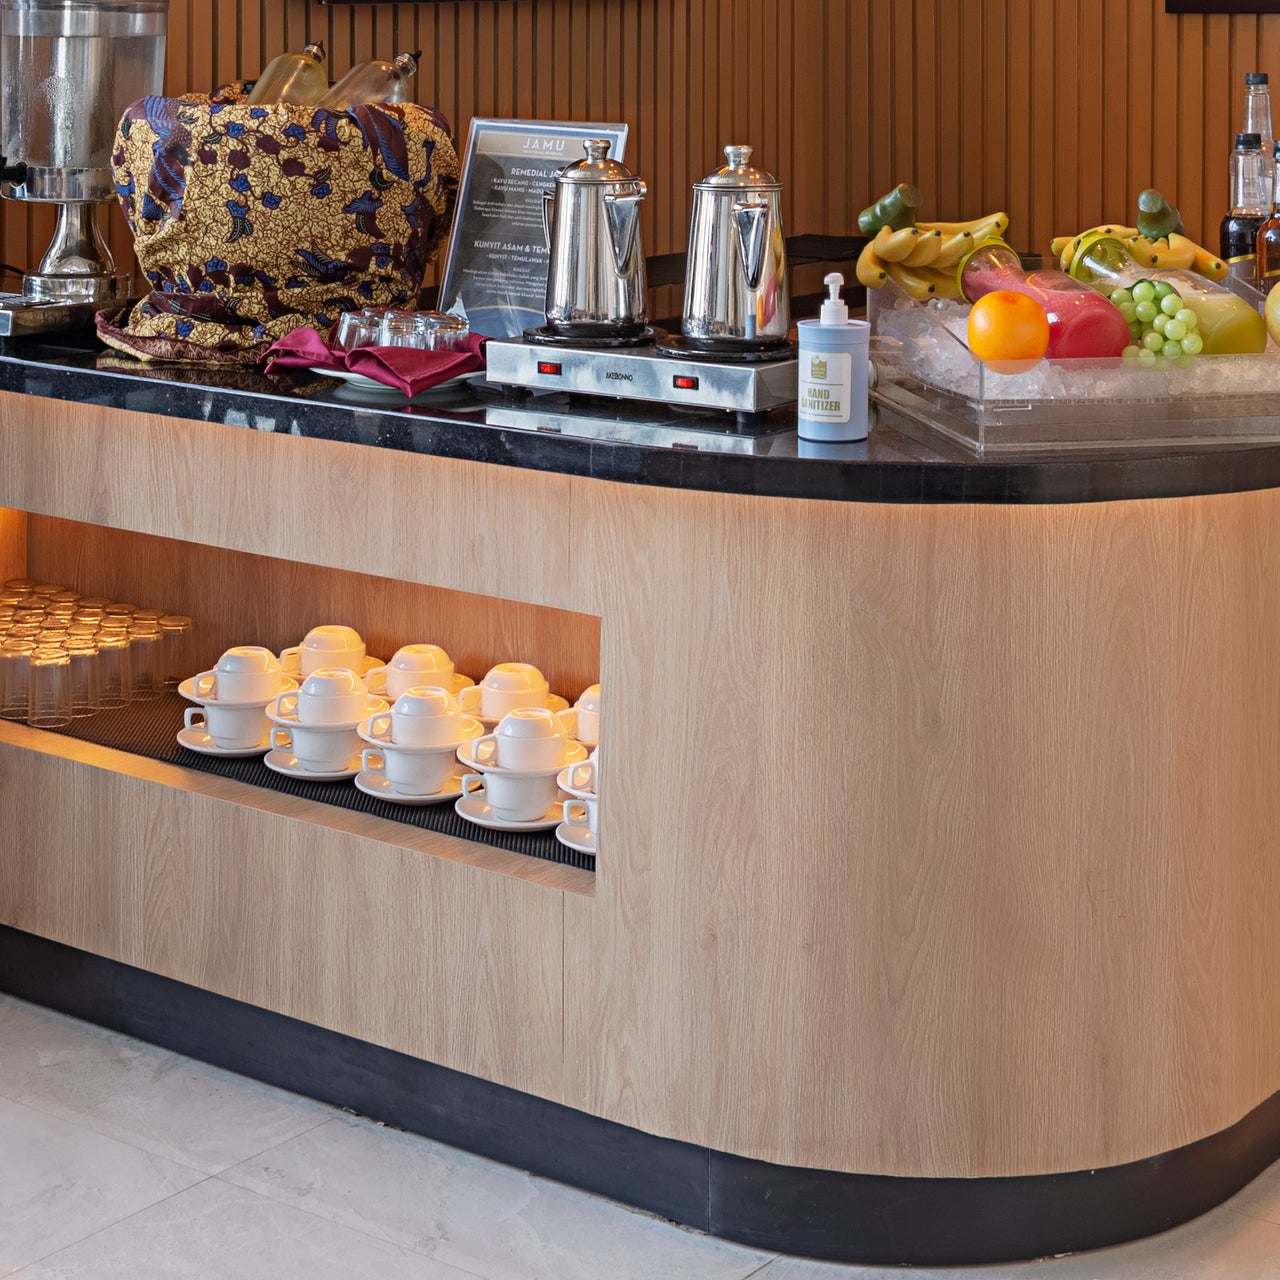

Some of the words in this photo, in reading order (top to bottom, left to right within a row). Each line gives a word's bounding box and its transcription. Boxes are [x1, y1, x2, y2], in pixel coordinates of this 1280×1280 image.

[522, 138, 565, 151] JAMU
[511, 168, 548, 177] REMEDIAL
[474, 240, 502, 250] KUNYIT
[502, 243, 523, 252] ASAM
[808, 388, 830, 400] HAND
[802, 398, 840, 412] SANITIZER
